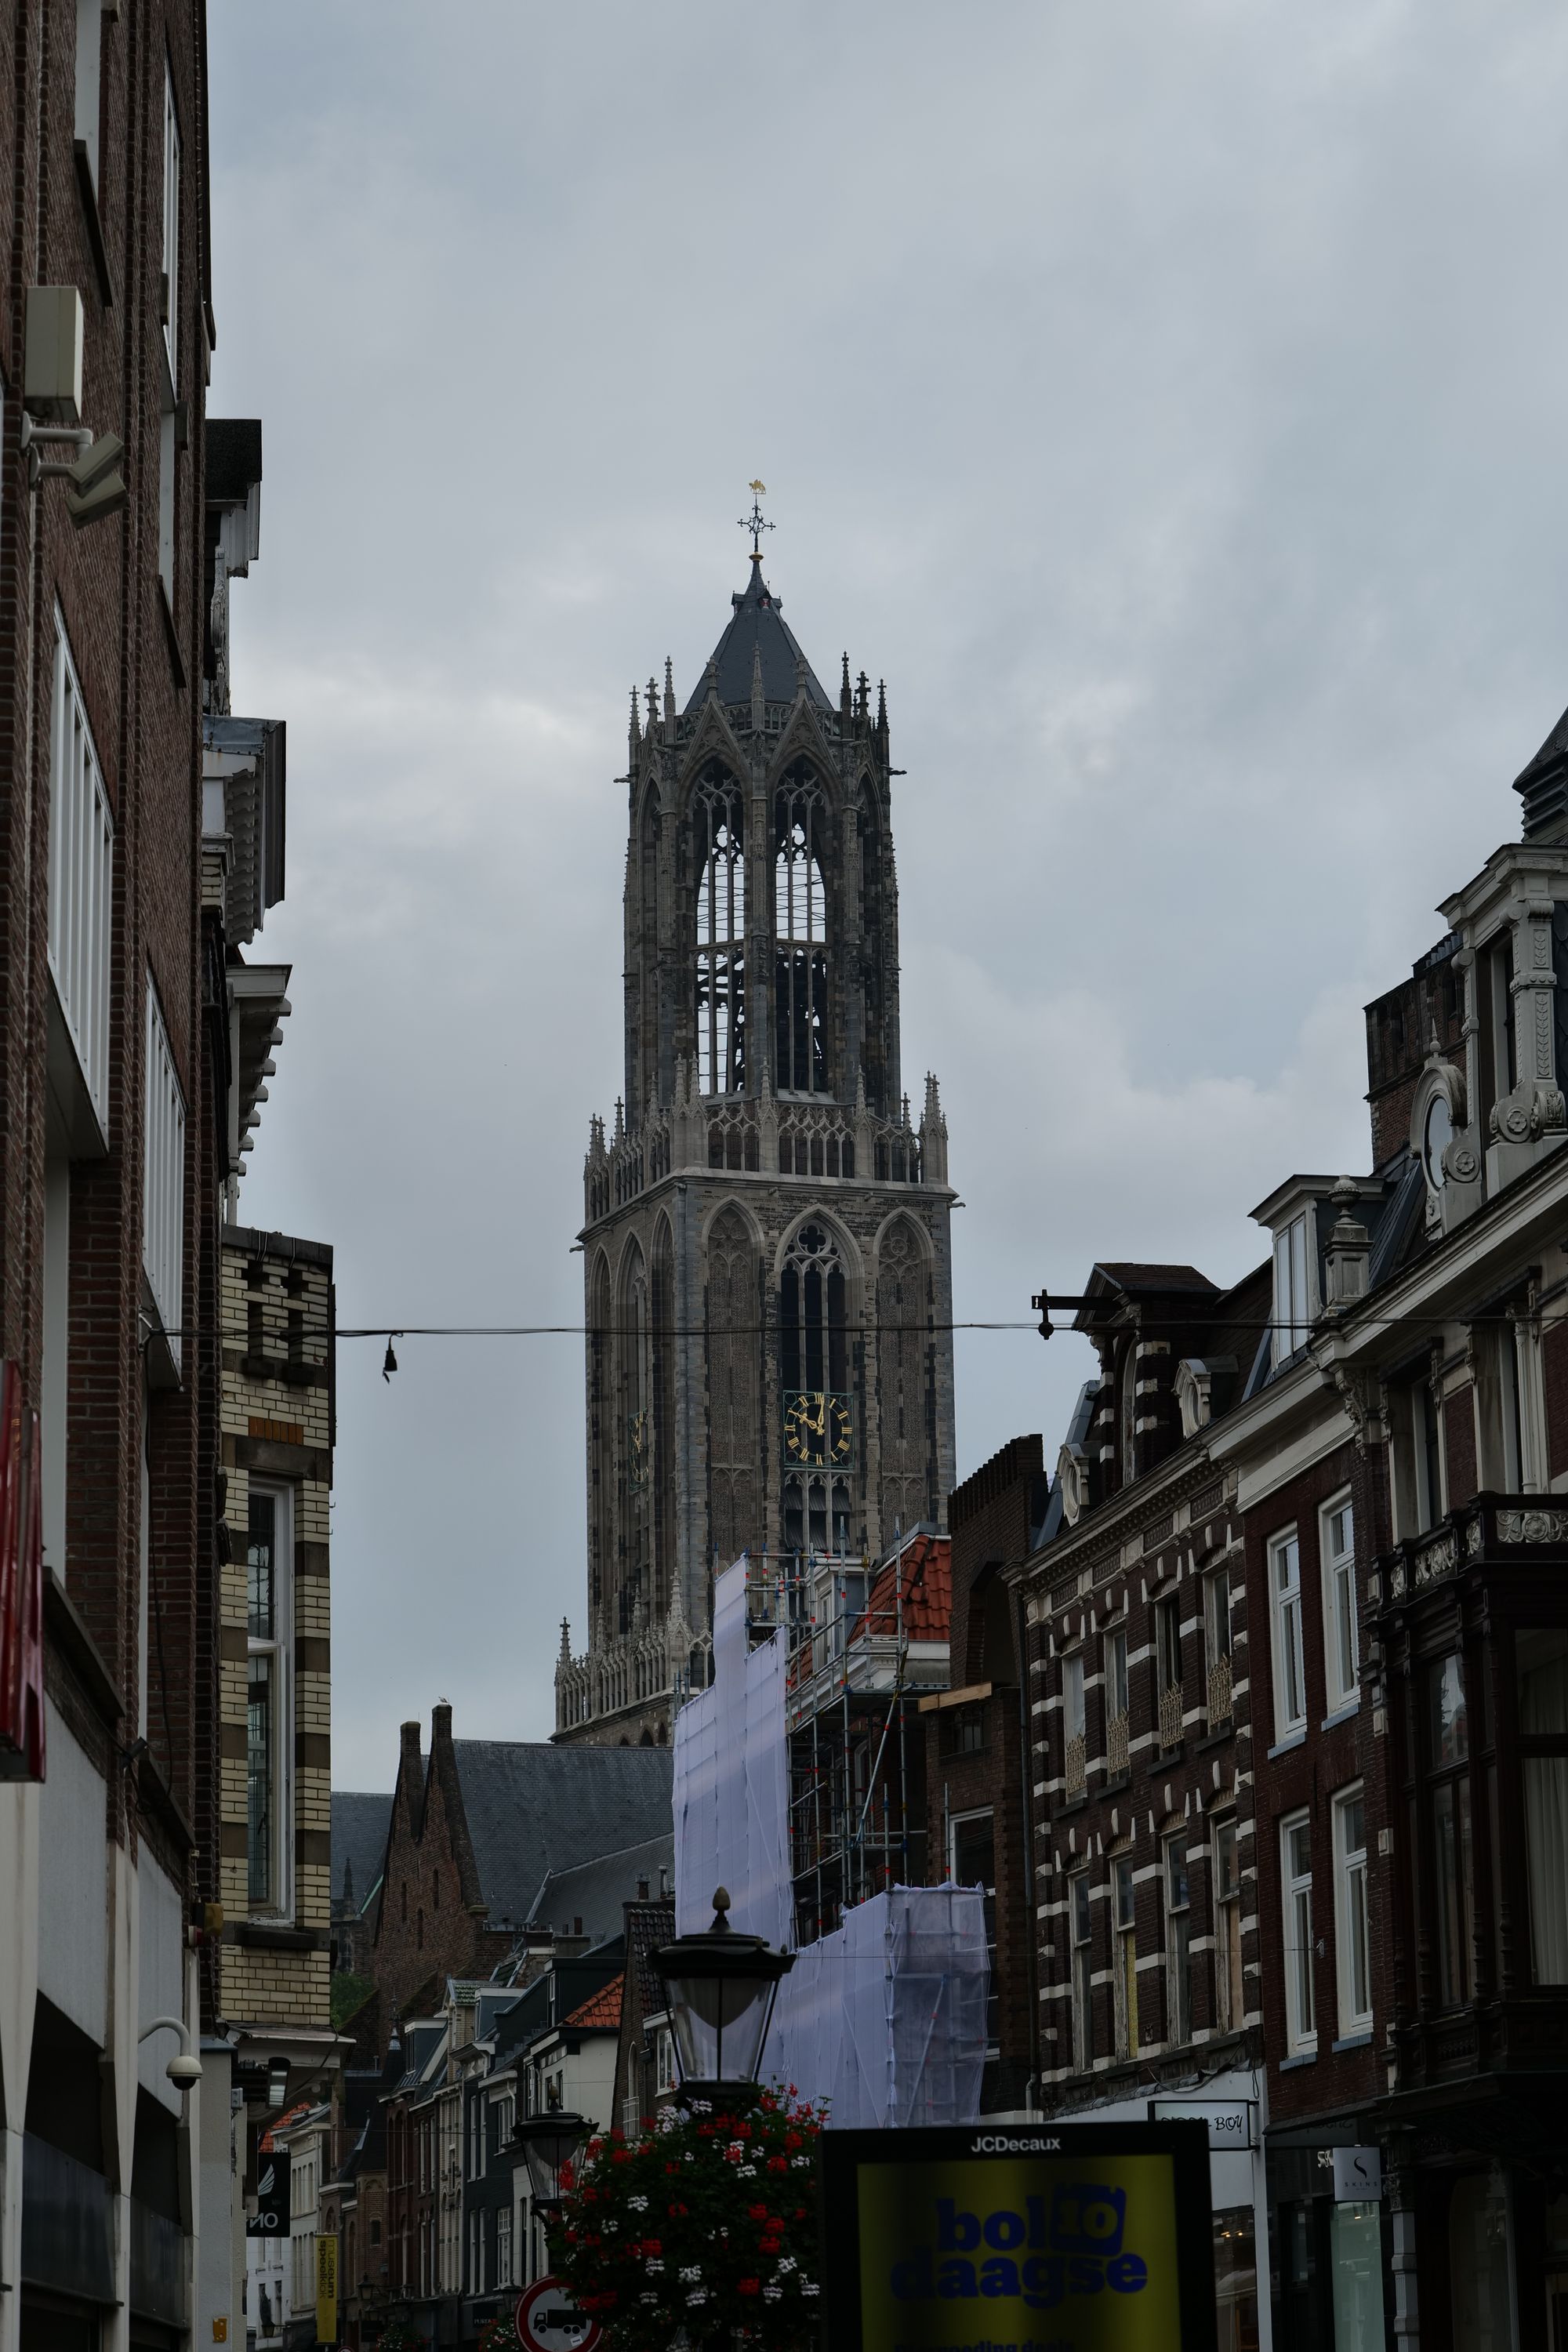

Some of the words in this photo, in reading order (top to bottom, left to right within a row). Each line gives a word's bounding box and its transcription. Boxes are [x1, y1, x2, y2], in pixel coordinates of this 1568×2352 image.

[971, 2136, 1061, 2154] JCDecaux
[936, 2196, 1046, 2252] bol
[318, 2240, 327, 2299] speelklok
[891, 2245, 1148, 2309] daagse
